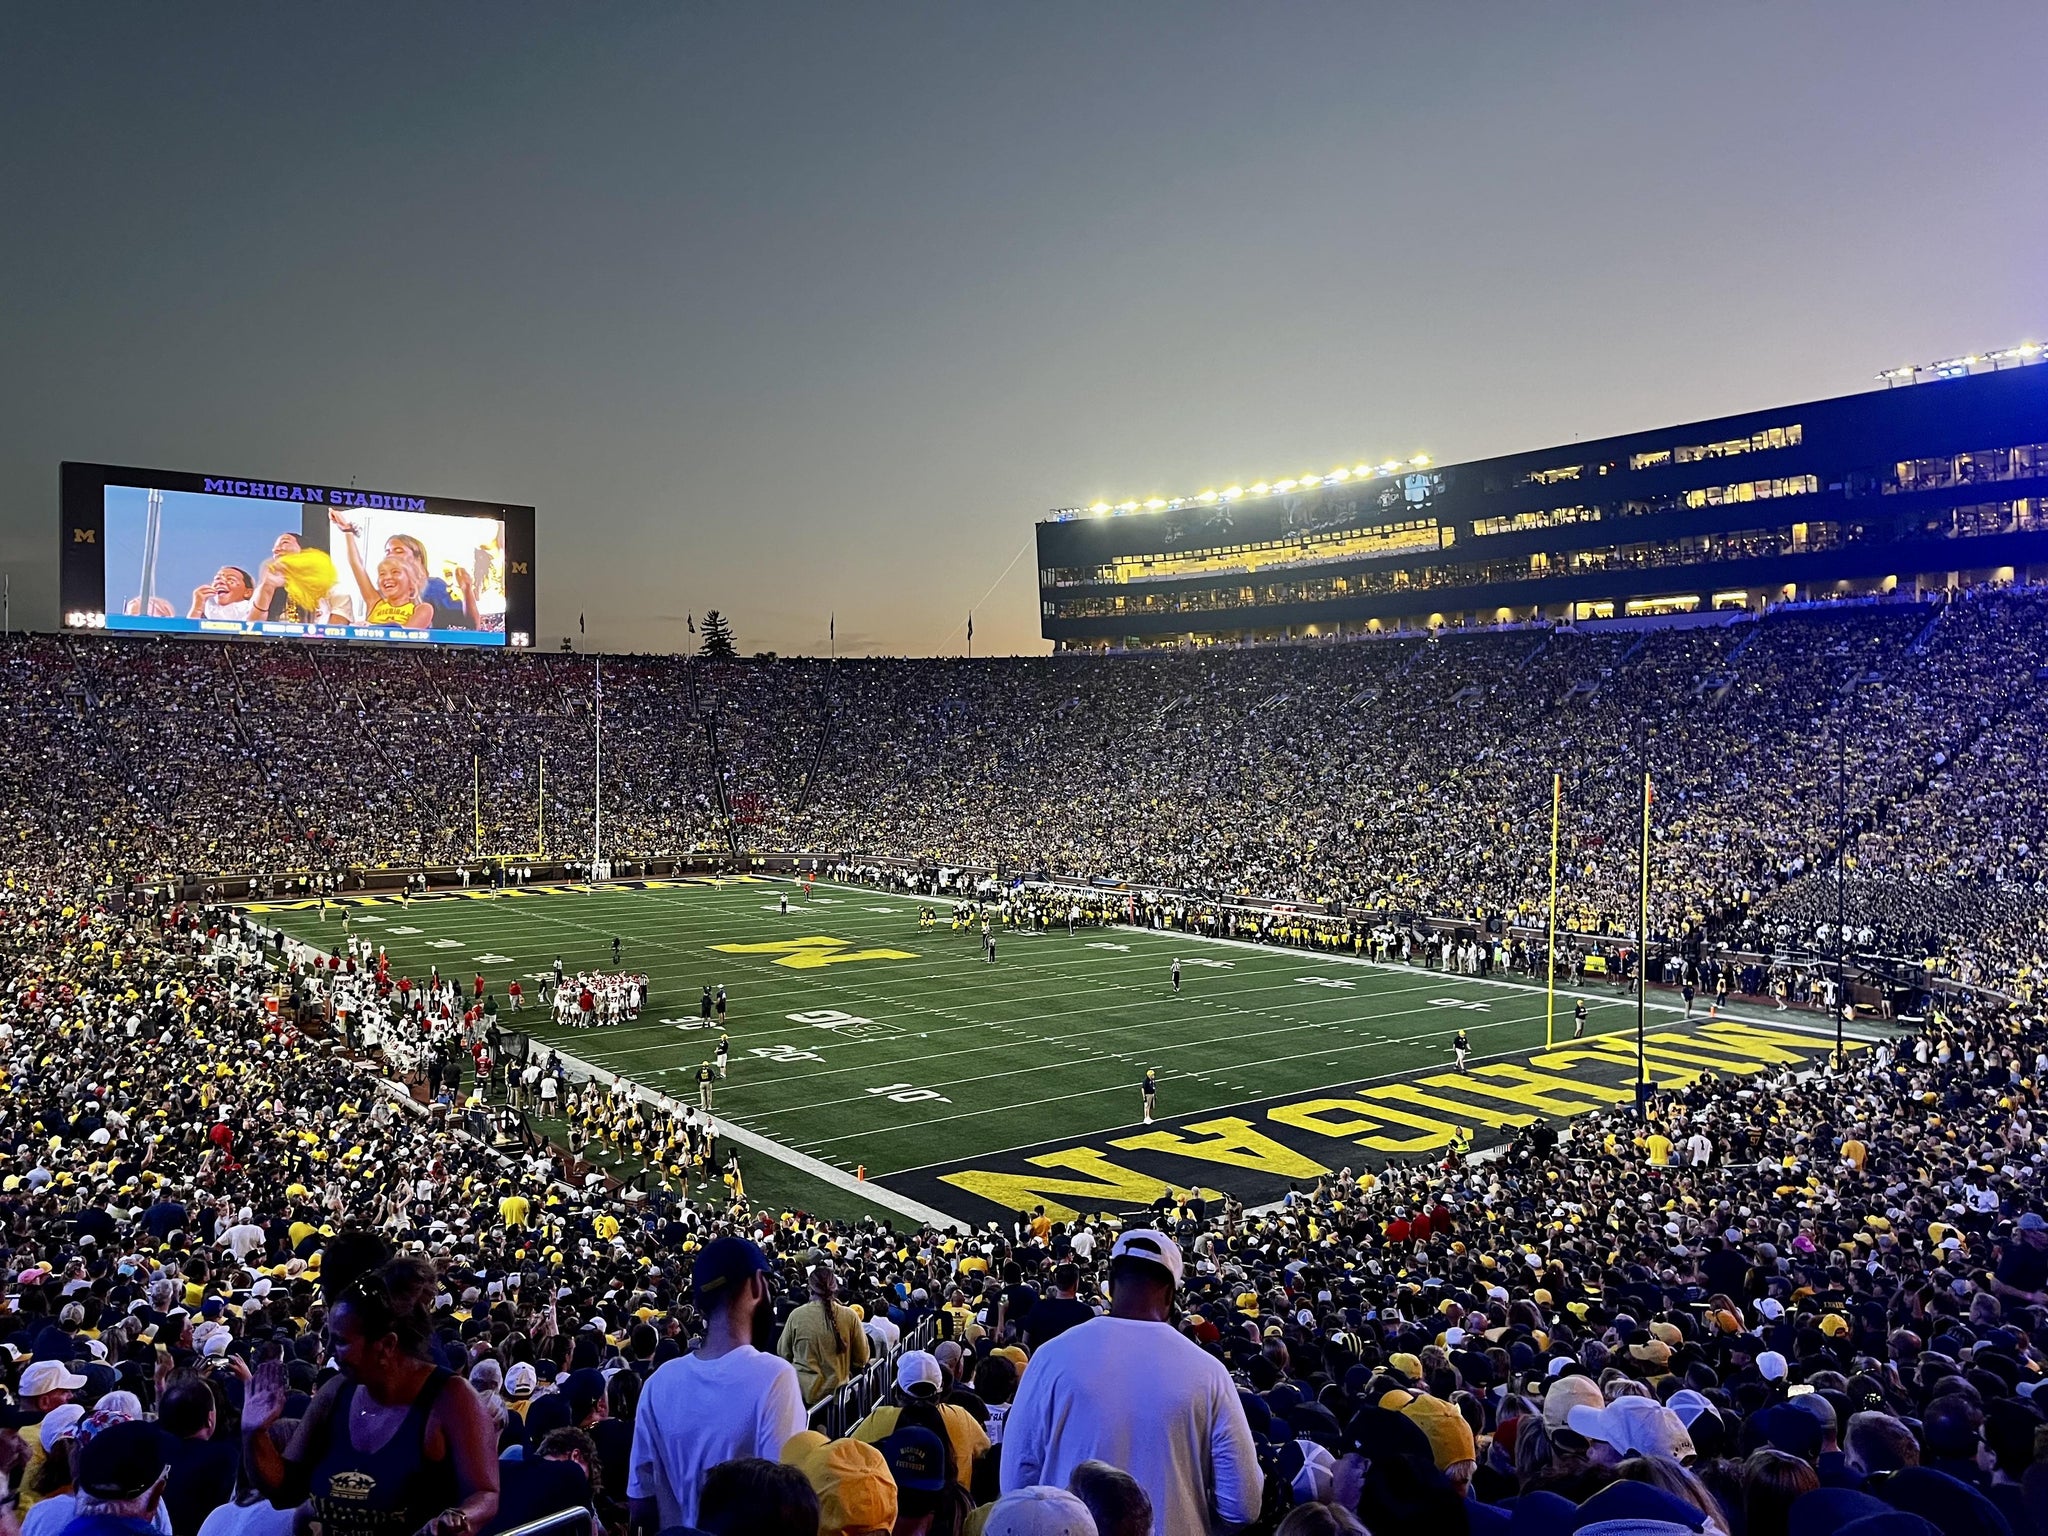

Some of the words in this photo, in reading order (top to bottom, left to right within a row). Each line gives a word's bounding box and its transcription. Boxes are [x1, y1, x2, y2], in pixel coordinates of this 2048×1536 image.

[204, 478, 323, 502] MICHIGAN
[330, 490, 425, 512] STADIUM
[74, 528, 95, 543] M
[511, 561, 527, 574] M
[705, 935, 922, 969] M
[659, 1015, 718, 1031] 30
[750, 1044, 819, 1063] 20
[865, 1083, 941, 1103] 10
